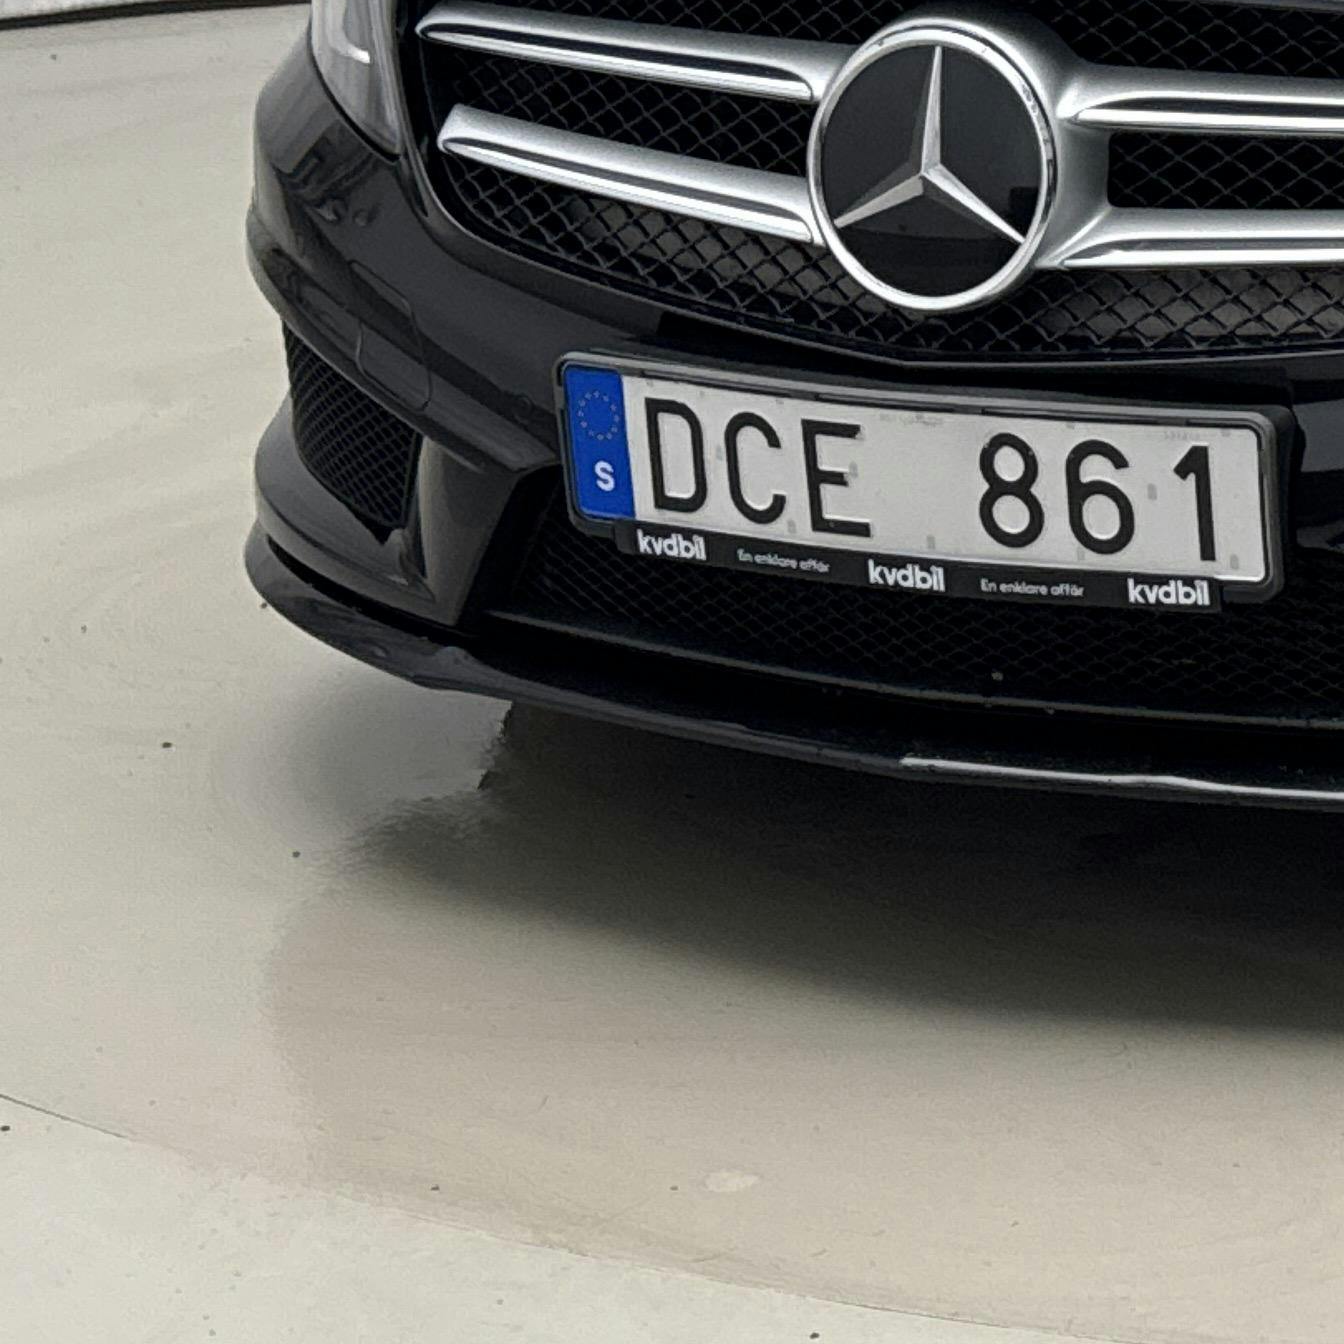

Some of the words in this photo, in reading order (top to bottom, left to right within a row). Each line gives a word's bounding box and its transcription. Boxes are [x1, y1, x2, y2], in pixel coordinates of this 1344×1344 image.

[594, 460, 616, 492] S
[644, 397, 872, 538] DCE
[979, 432, 1217, 562] 861
[636, 529, 707, 561] kvdbil
[868, 559, 946, 593] kvdbil
[980, 578, 997, 594] En
[1127, 578, 1211, 606] kvdbil
